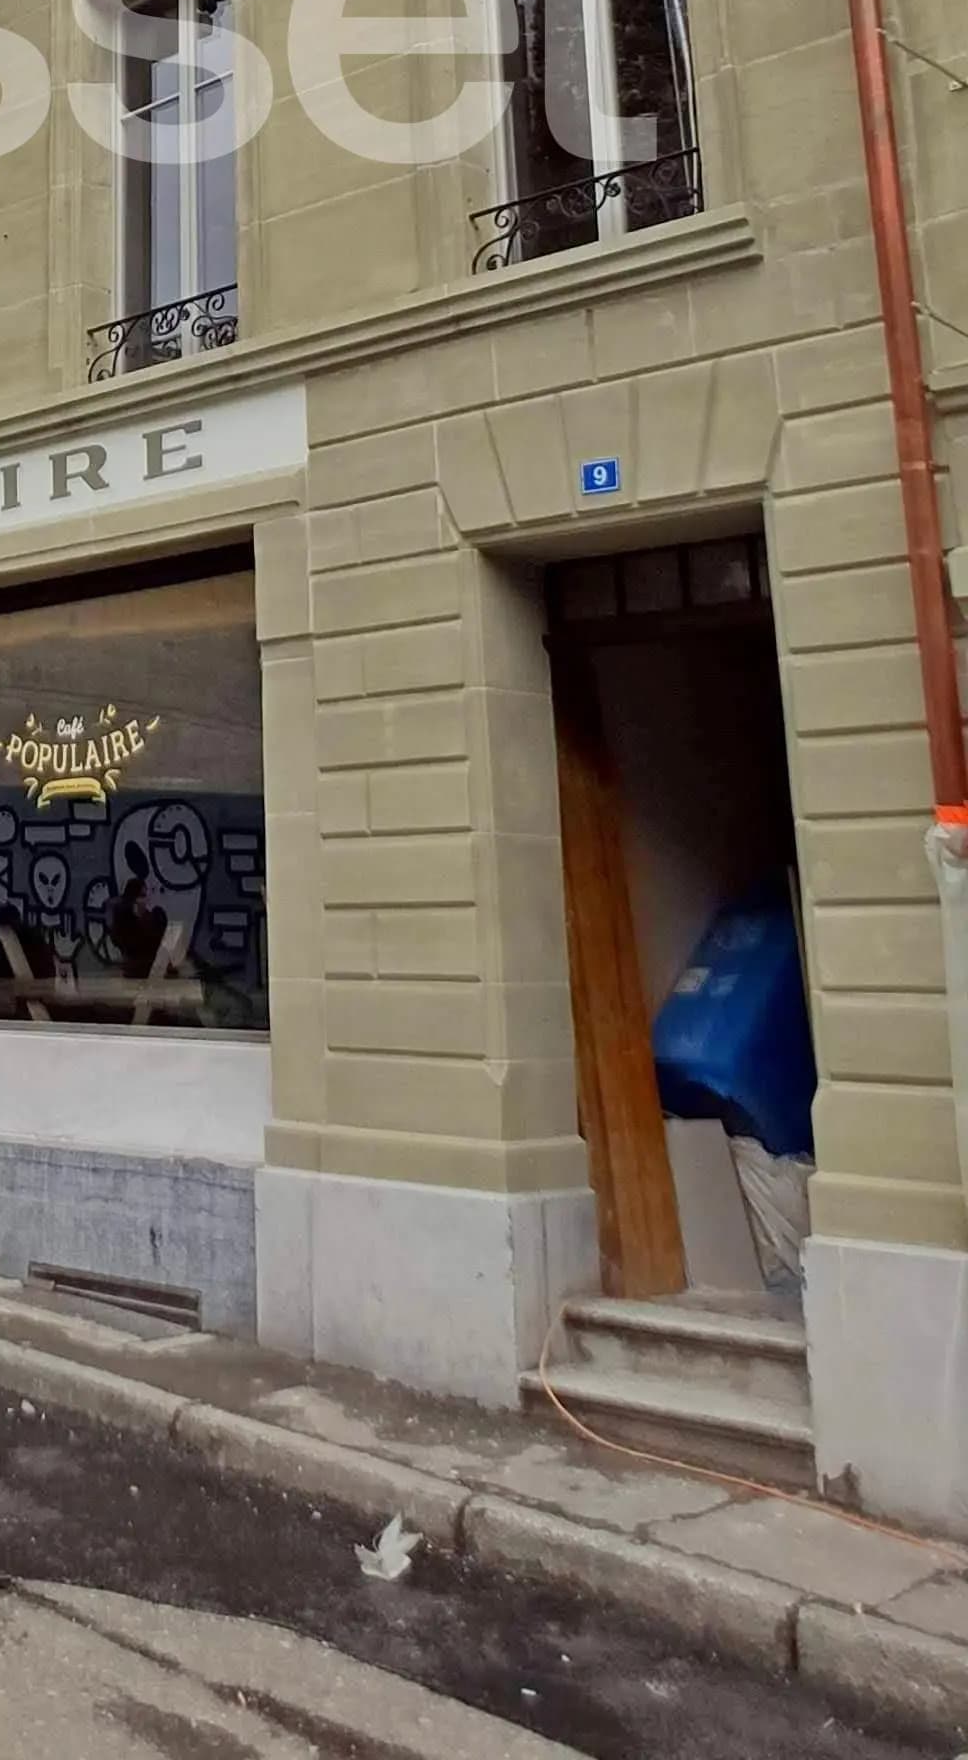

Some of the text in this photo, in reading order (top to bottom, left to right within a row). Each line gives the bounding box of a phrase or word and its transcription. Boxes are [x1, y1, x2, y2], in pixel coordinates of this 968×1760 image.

[593, 466, 607, 486] 9
[57, 715, 85, 739] Café
[5, 719, 145, 773] POPULAIRE
